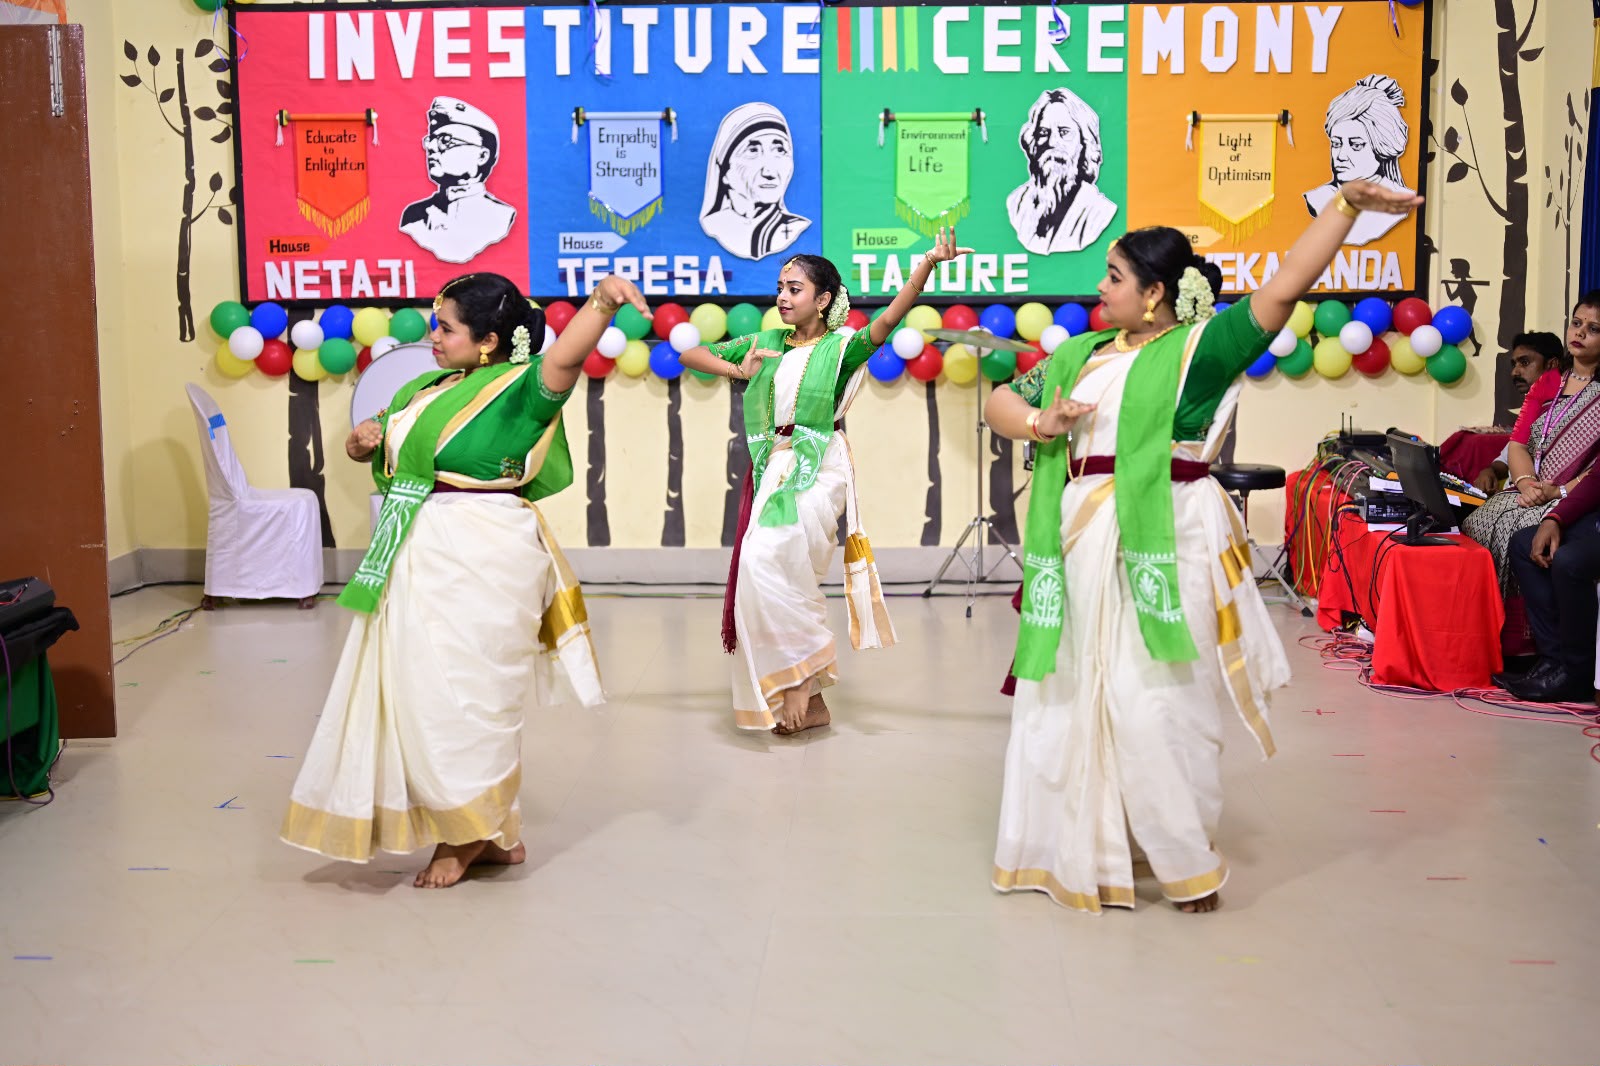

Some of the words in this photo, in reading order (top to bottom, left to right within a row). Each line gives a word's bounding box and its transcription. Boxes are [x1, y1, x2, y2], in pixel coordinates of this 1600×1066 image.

[308, 6, 821, 81] INVESTITURE
[933, 5, 1344, 75] CEREMONY
[305, 129, 358, 144] Educate
[598, 127, 658, 148] Empathy
[901, 128, 966, 140] Environment
[1219, 132, 1253, 151] Light
[323, 146, 335, 154] to
[616, 146, 627, 159] is
[919, 143, 938, 153] for
[909, 155, 944, 173] Life
[1230, 152, 1242, 162] of
[305, 157, 365, 177] Enlighten
[596, 161, 657, 186] Strength
[1208, 166, 1272, 186] Optimism
[269, 239, 310, 253] House
[562, 236, 603, 250] House
[856, 232, 898, 246] House
[264, 259, 416, 299] NETAJI
